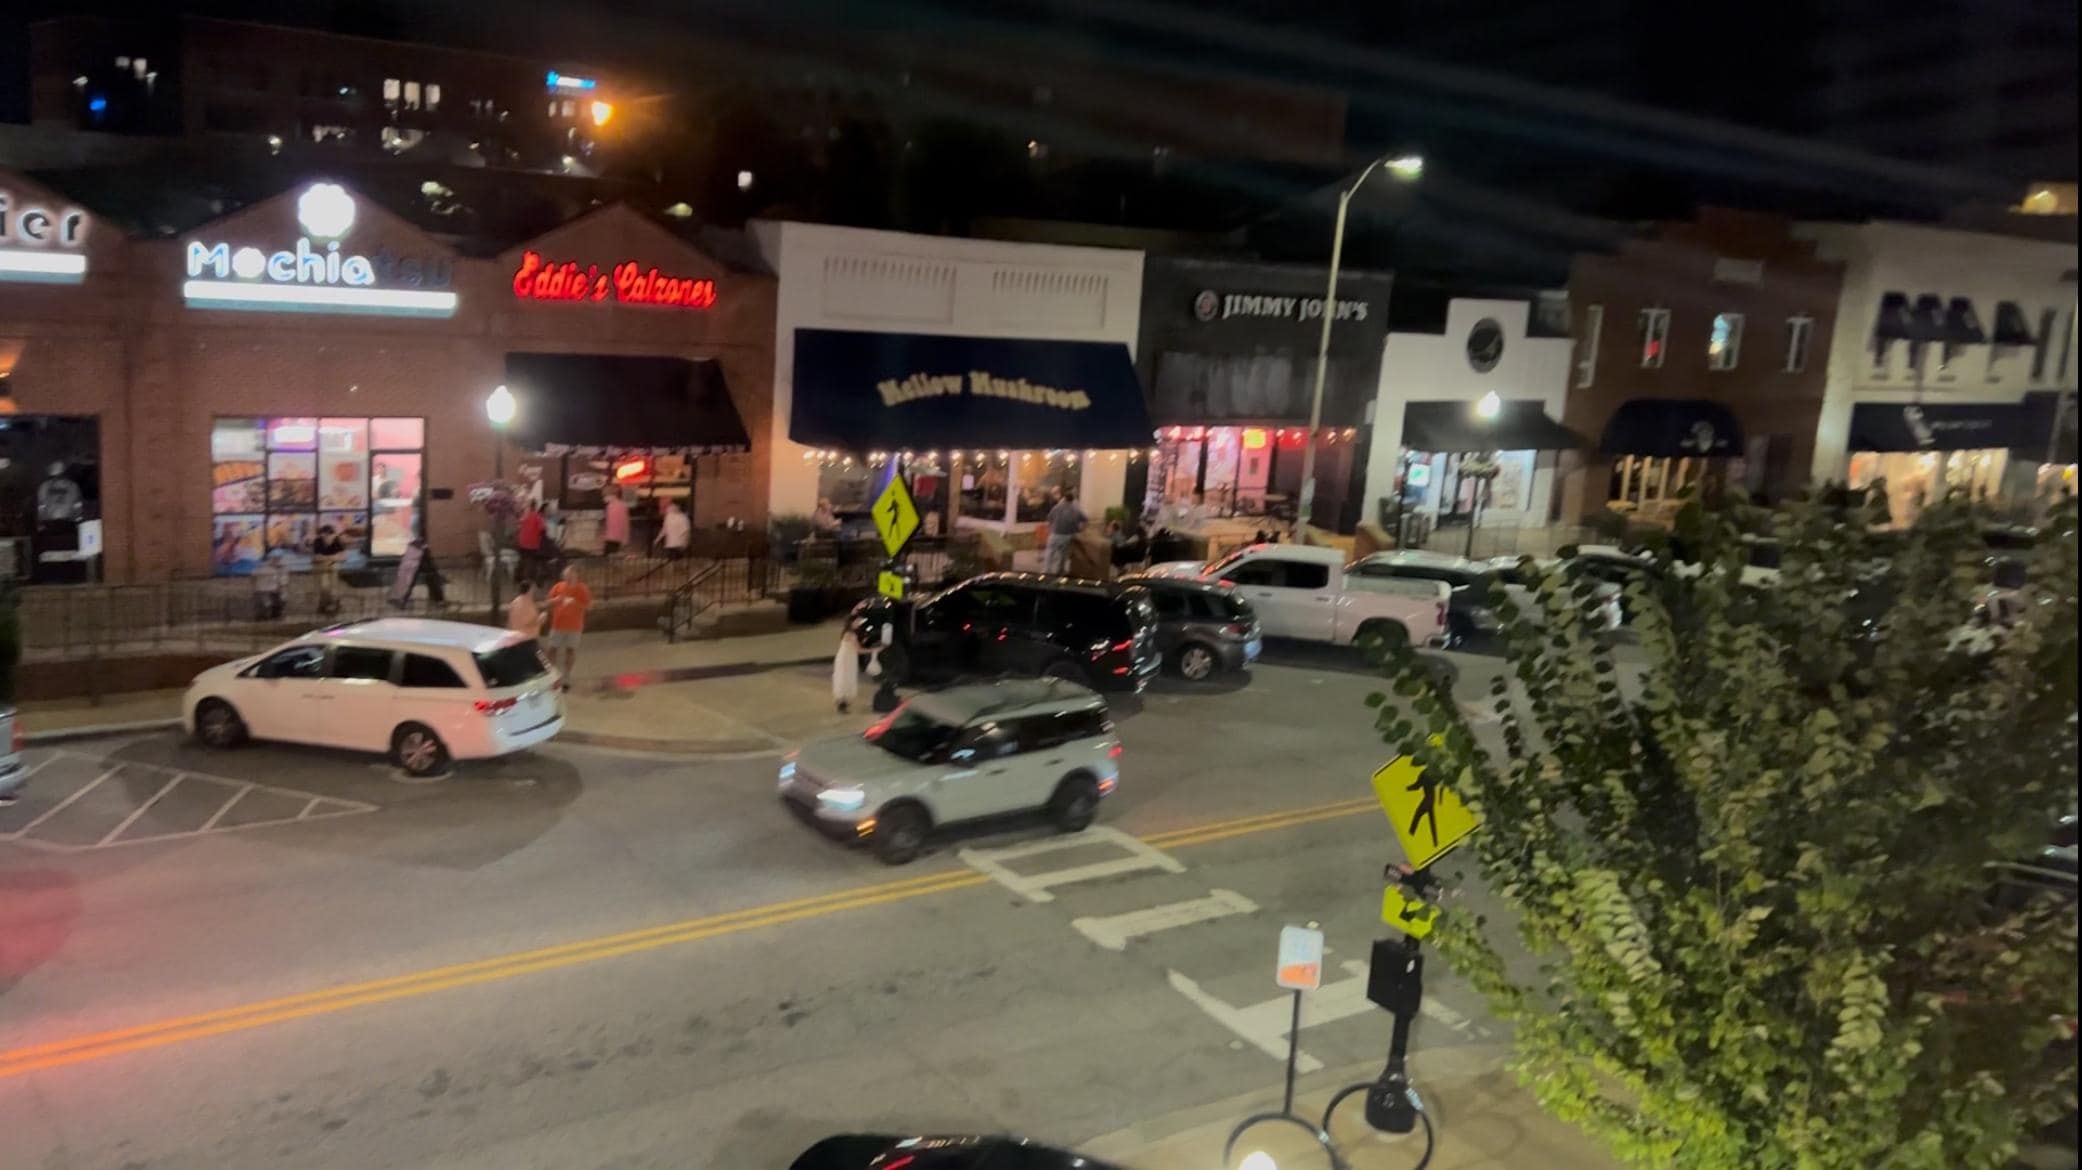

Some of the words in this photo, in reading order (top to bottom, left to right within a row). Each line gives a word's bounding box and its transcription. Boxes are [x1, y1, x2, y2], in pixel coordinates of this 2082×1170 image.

[513, 251, 609, 301] Eddie's
[613, 261, 717, 308] Calzones
[1222, 294, 1297, 320] JIMMY
[877, 372, 963, 407] Mellow
[968, 370, 1092, 410] Mushroom
